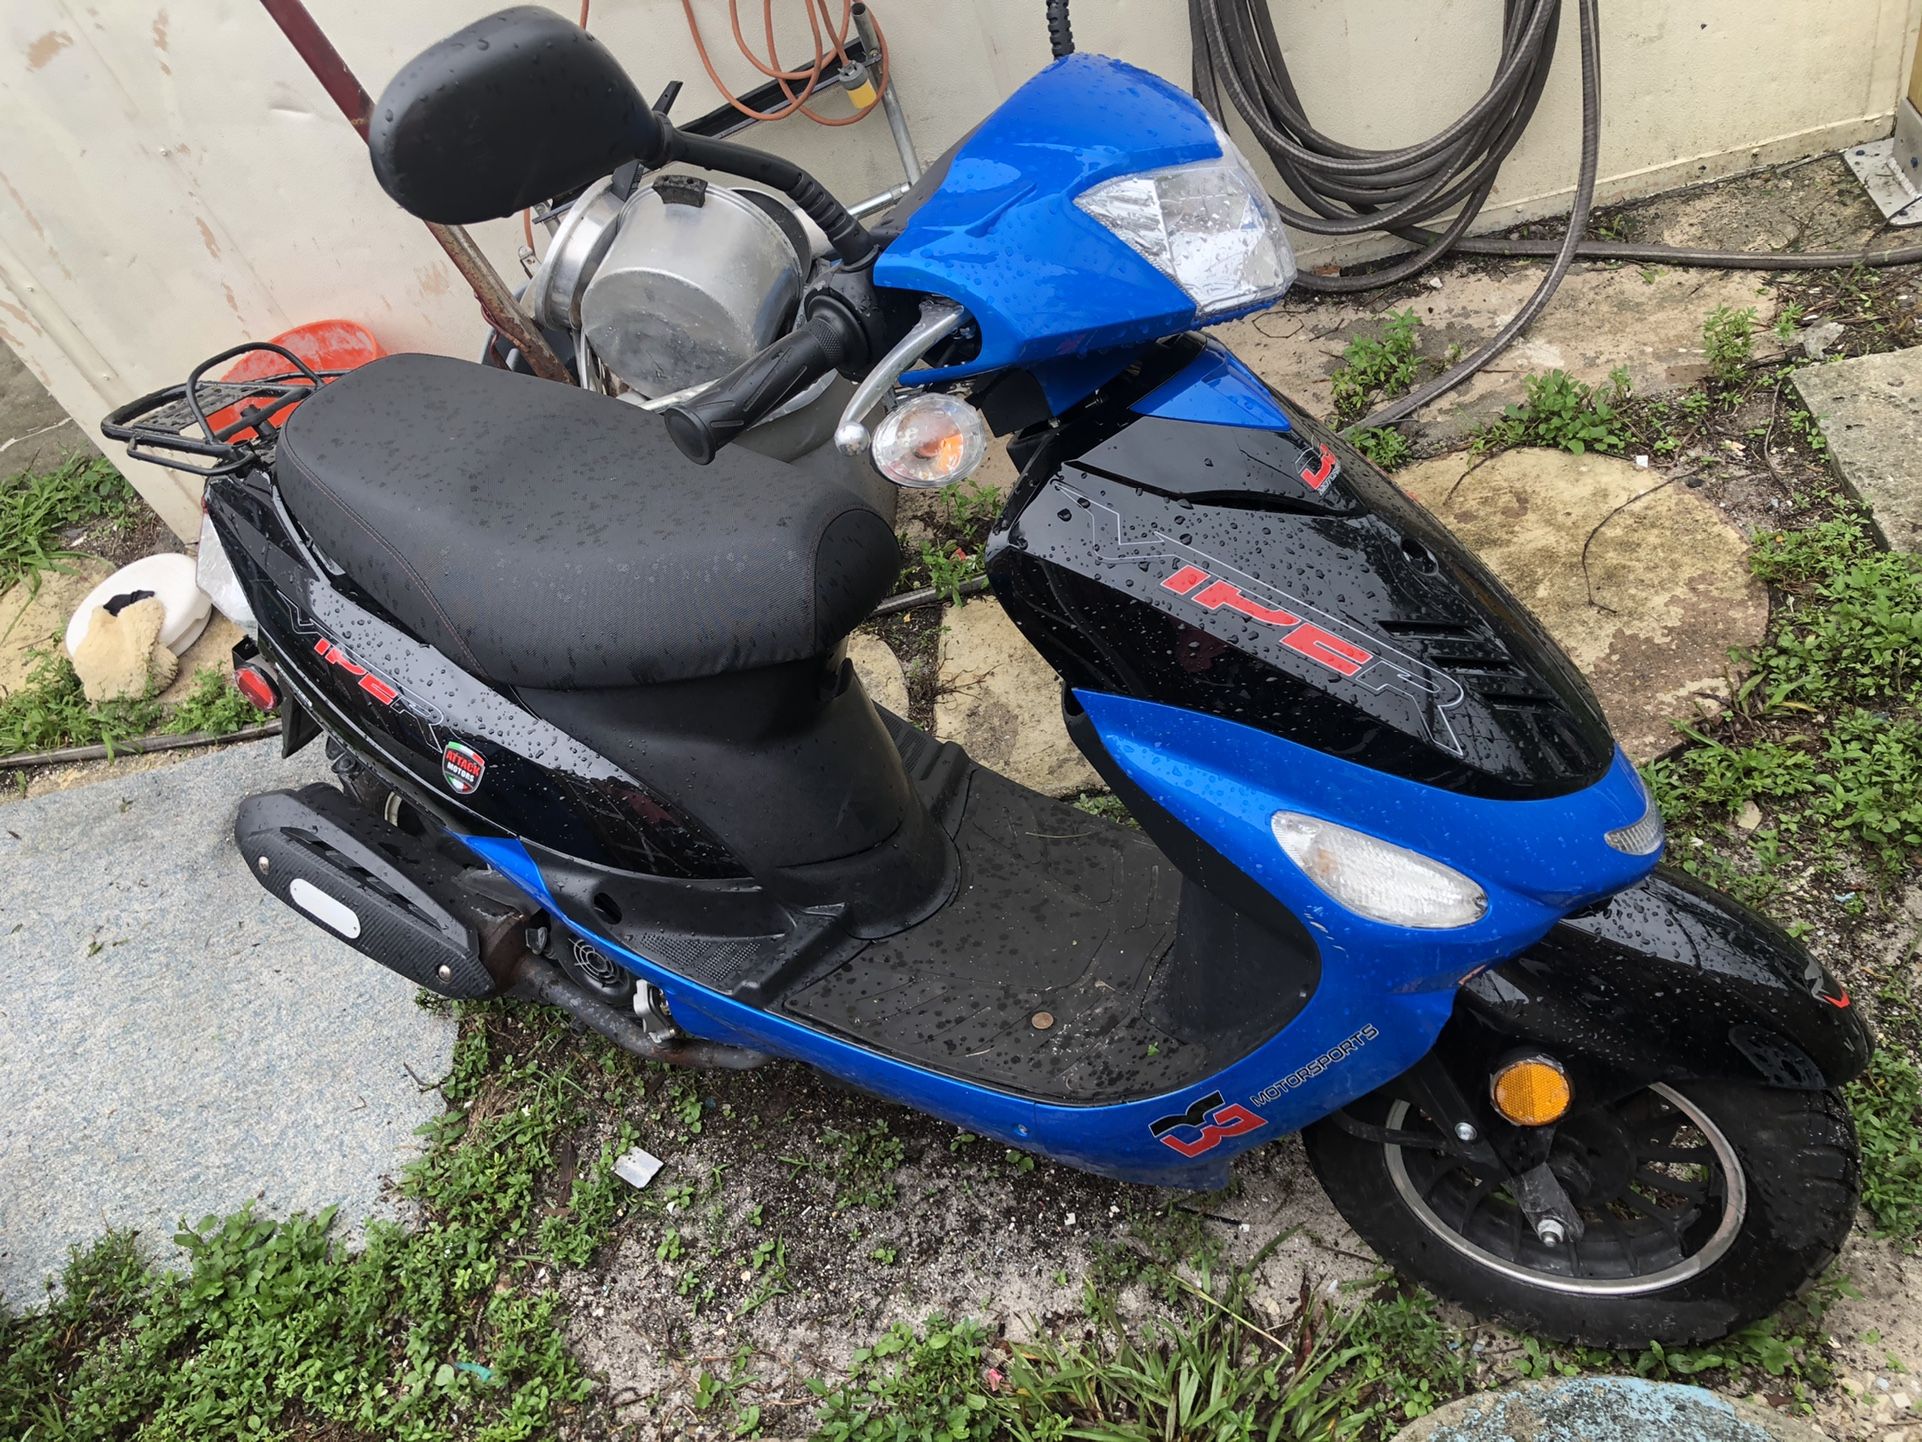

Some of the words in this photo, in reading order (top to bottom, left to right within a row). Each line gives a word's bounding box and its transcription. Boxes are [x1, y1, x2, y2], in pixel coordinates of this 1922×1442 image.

[1053, 480, 1464, 757] VIPER
[277, 589, 443, 753] VIPER
[446, 750, 481, 777] ATTACK
[447, 761, 475, 783] MOTORS
[1250, 1023, 1379, 1107] MOTORSPORTS
